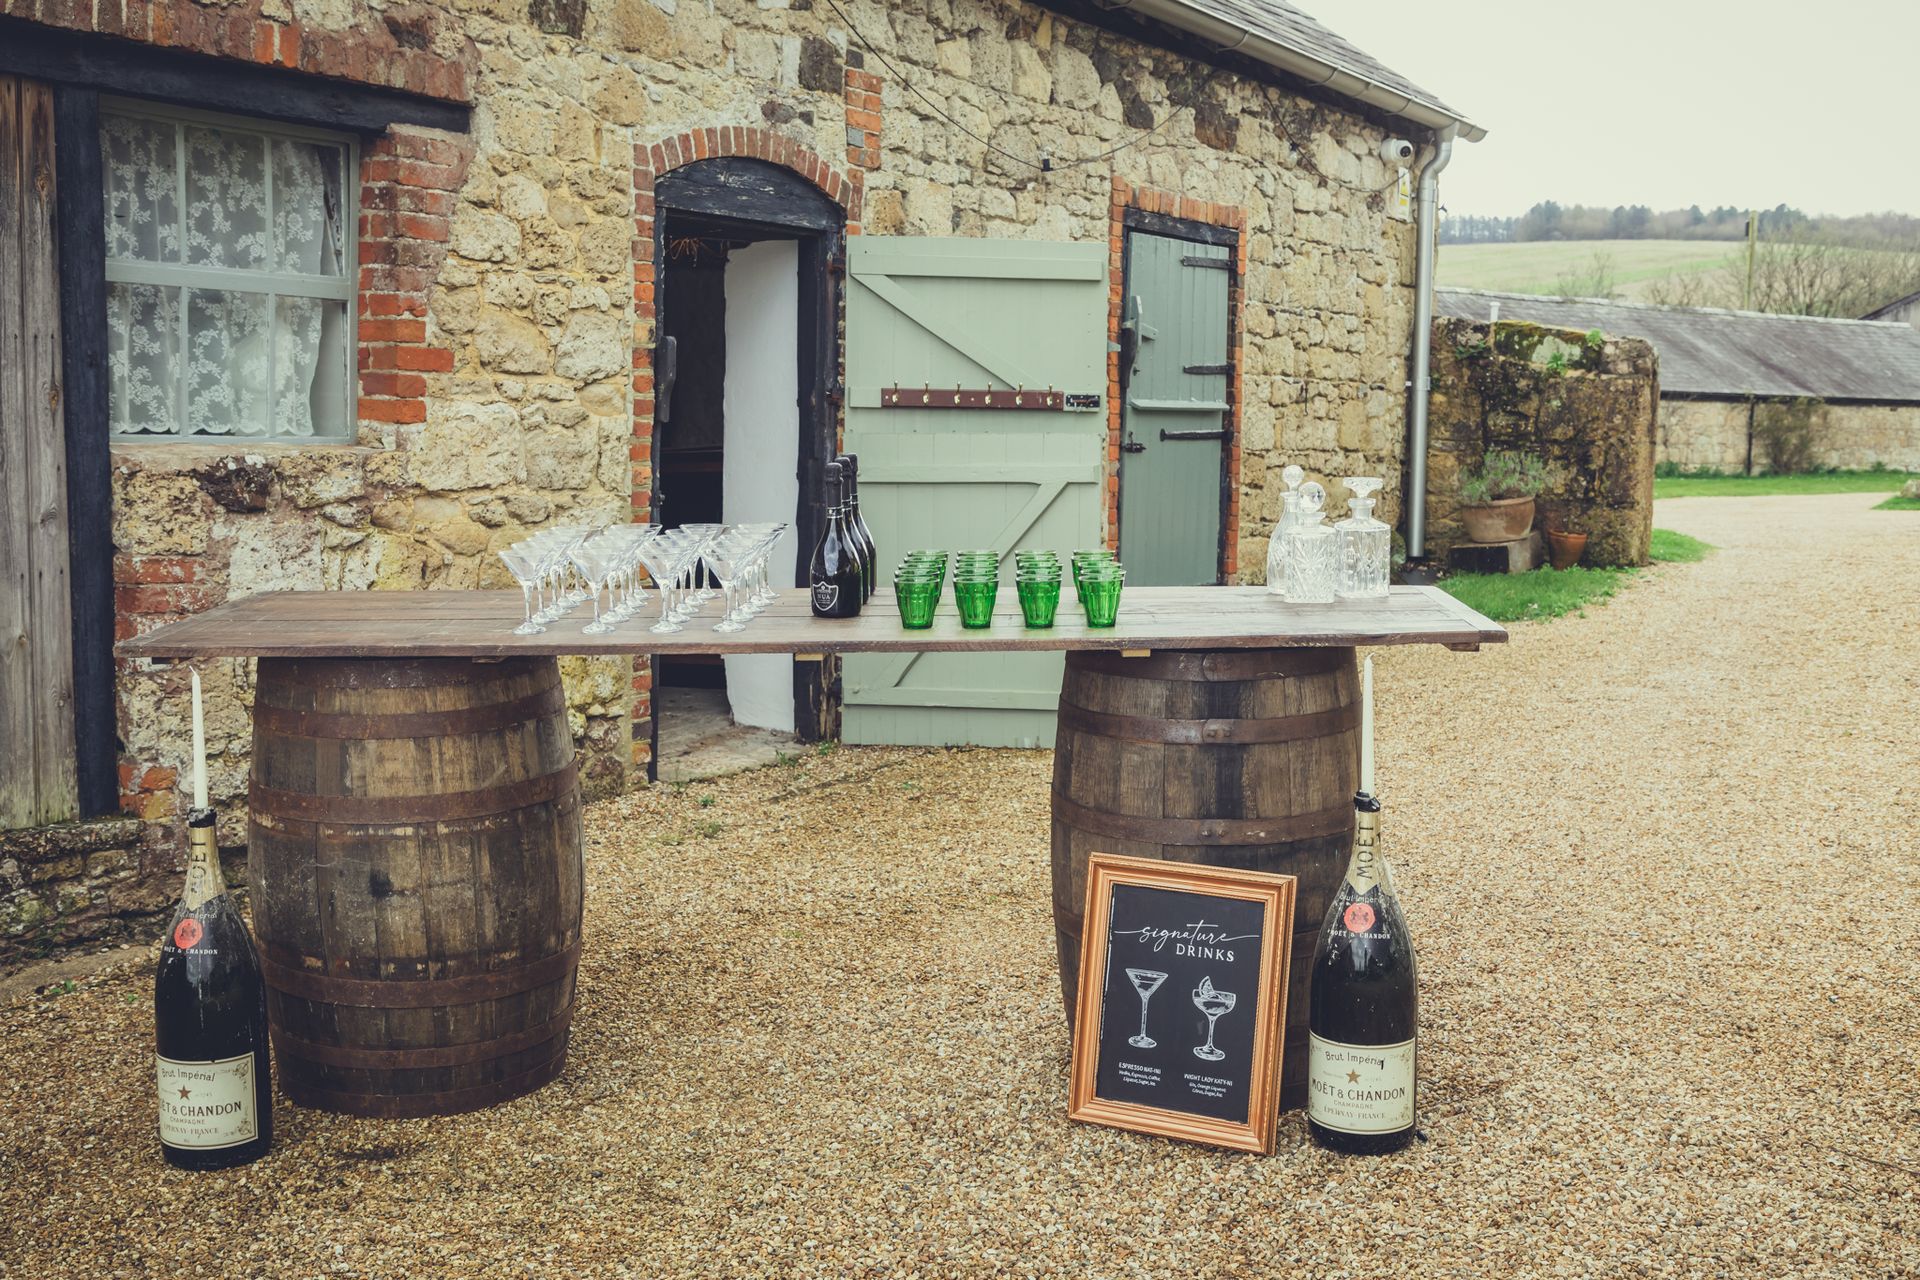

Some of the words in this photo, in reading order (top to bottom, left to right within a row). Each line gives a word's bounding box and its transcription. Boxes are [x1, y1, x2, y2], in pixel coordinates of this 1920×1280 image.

[1114, 920, 1259, 952] signature
[1176, 943, 1234, 962] DRINKS
[1325, 1051, 1344, 1061] Brut
[178, 1068, 215, 1082] Impérial
[1337, 1089, 1344, 1098] &
[1347, 1086, 1405, 1101] CHANDON
[172, 1106, 177, 1115] &
[180, 1101, 242, 1117] CHANDON
[1333, 1100, 1374, 1110] CHAMPAGNE
[169, 1116, 205, 1125] CHAMPAGNE
[190, 1127, 219, 1135] FRANCE
